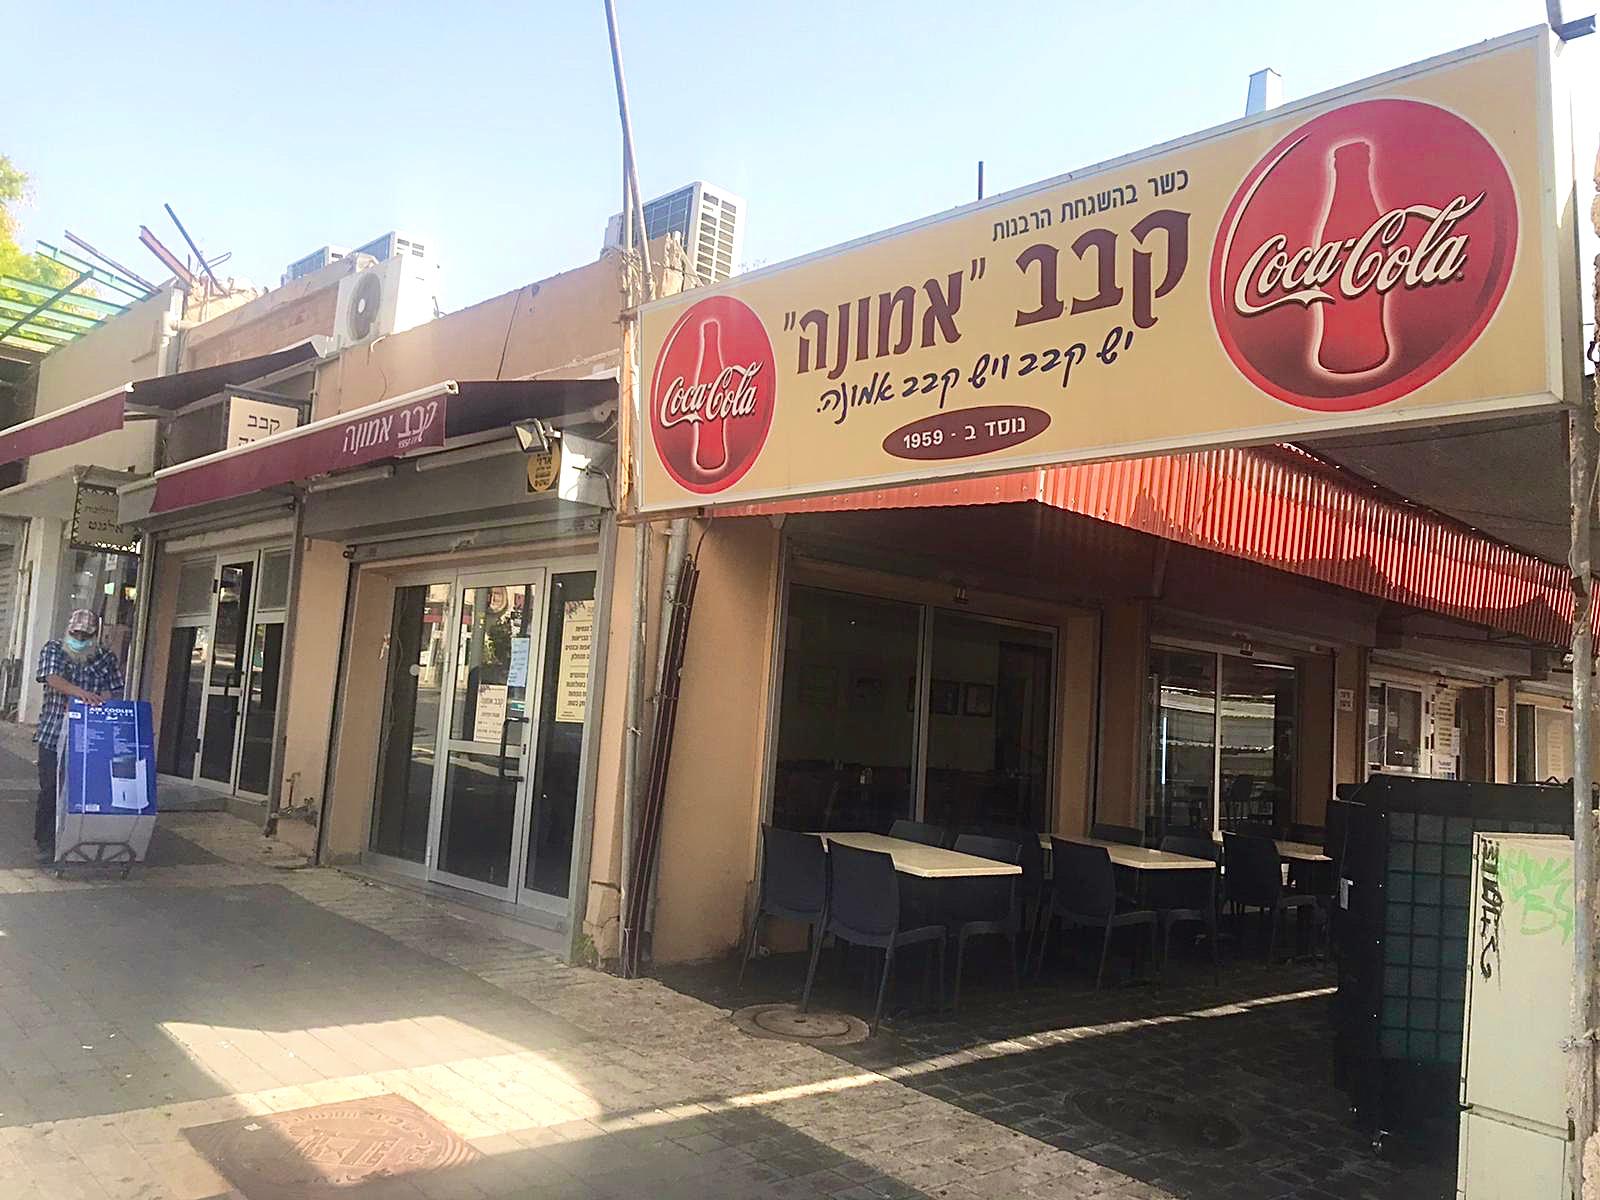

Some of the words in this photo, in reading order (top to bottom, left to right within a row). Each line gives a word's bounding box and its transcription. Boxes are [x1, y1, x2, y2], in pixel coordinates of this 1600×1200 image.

[1147, 168, 1190, 198] כשר
[1060, 184, 1138, 223] בהשגחת
[991, 207, 1052, 242] הרבנות
[1014, 208, 1192, 329] קבב
[1233, 190, 1487, 317] Coca-Cola
[782, 256, 987, 380] "אמונה"
[1017, 341, 1087, 388] קבב
[1094, 326, 1135, 365] יש
[900, 367, 960, 409] קבב
[966, 352, 1010, 390] ויש
[659, 359, 764, 429] Coca-Cola
[247, 414, 281, 436] קבב
[342, 413, 394, 456] אמונה
[396, 400, 439, 443] קבב
[902, 430, 945, 449] 1959
[963, 423, 977, 442] ב
[984, 415, 1027, 438] נוסד
